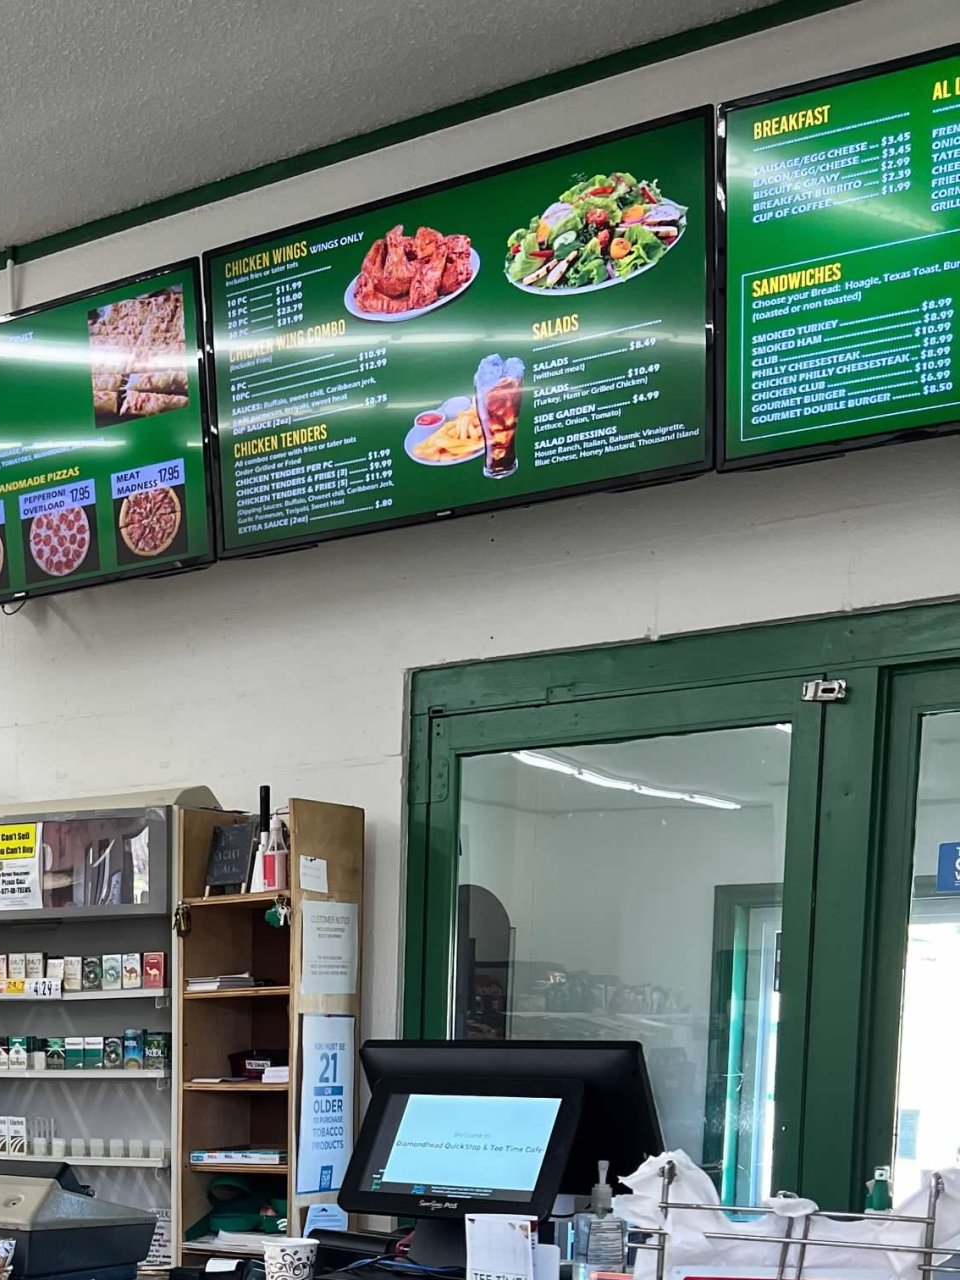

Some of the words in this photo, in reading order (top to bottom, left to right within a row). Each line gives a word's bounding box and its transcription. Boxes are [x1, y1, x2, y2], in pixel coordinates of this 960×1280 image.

[753, 104, 830, 140] BREAKFAST
[753, 151, 826, 177] SAUSAGE/EGG
[827, 141, 867, 159] CHEESE
[881, 131, 910, 147] $3.45
[752, 211, 773, 224] CUP
[775, 207, 789, 218] OF
[791, 198, 832, 215] COFFEE
[881, 180, 910, 195] $1.99
[225, 251, 269, 278] CHICKEN
[272, 240, 307, 265] WINGS
[309, 238, 338, 254] WINGS
[340, 231, 364, 245] ONLY
[227, 299, 235, 307] 10
[237, 296, 247, 305] PC
[275, 280, 301, 294] $11.99
[752, 261, 841, 299] SANDWICHES
[532, 313, 578, 341] SALADS
[752, 327, 795, 345] SMOKED
[797, 319, 838, 336] TURKEY
[921, 296, 952, 312] $8.99
[533, 356, 568, 371] SALADS
[629, 336, 656, 350] $8.49
[752, 355, 777, 368] CLUB
[914, 320, 950, 337] $10.99
[752, 365, 787, 380] PHILLY
[788, 349, 860, 374] CHEESESTEAK
[923, 332, 953, 348] $8.99
[533, 383, 568, 397] SALADS
[627, 363, 659, 378] $10.49
[752, 374, 796, 392] CHICKEN
[799, 367, 834, 383] PHILLY
[836, 351, 909, 376] CHEESESTEAK
[920, 344, 950, 360] $8.99
[534, 412, 554, 423] SIDE
[555, 404, 595, 419] GARDEN
[632, 390, 659, 403] $4.99
[752, 396, 801, 415] GOURMET
[803, 387, 845, 405] BURGER
[920, 368, 950, 384] $6.99
[752, 407, 801, 426] GOURMET
[803, 399, 846, 417] DOUBLE
[847, 391, 890, 409] BURGER
[923, 380, 953, 396] $8.50
[234, 434, 277, 457] CHICKEN
[280, 423, 327, 448] TENDERS
[534, 436, 564, 449] SALAD
[566, 426, 616, 443] DRESSINGS
[47, 466, 79, 482] PIZZAS
[116, 470, 140, 484] MEAT
[158, 464, 179, 483] 17.95
[116, 477, 158, 495] MADNESS
[23, 488, 65, 505] PEPPERONI
[69, 485, 90, 503] 17.95
[23, 499, 65, 516] OVERLOAD
[1, 833, 17, 842] Can't
[5, 847, 22, 855] Can't
[319, 1052, 338, 1083] 21
[313, 1099, 343, 1113] OLDER
[312, 1126, 344, 1138] TOBACCO
[312, 1140, 344, 1150] PRODUCTS
[396, 1141, 444, 1149] Diamondhead
[505, 1145, 523, 1153] Time
